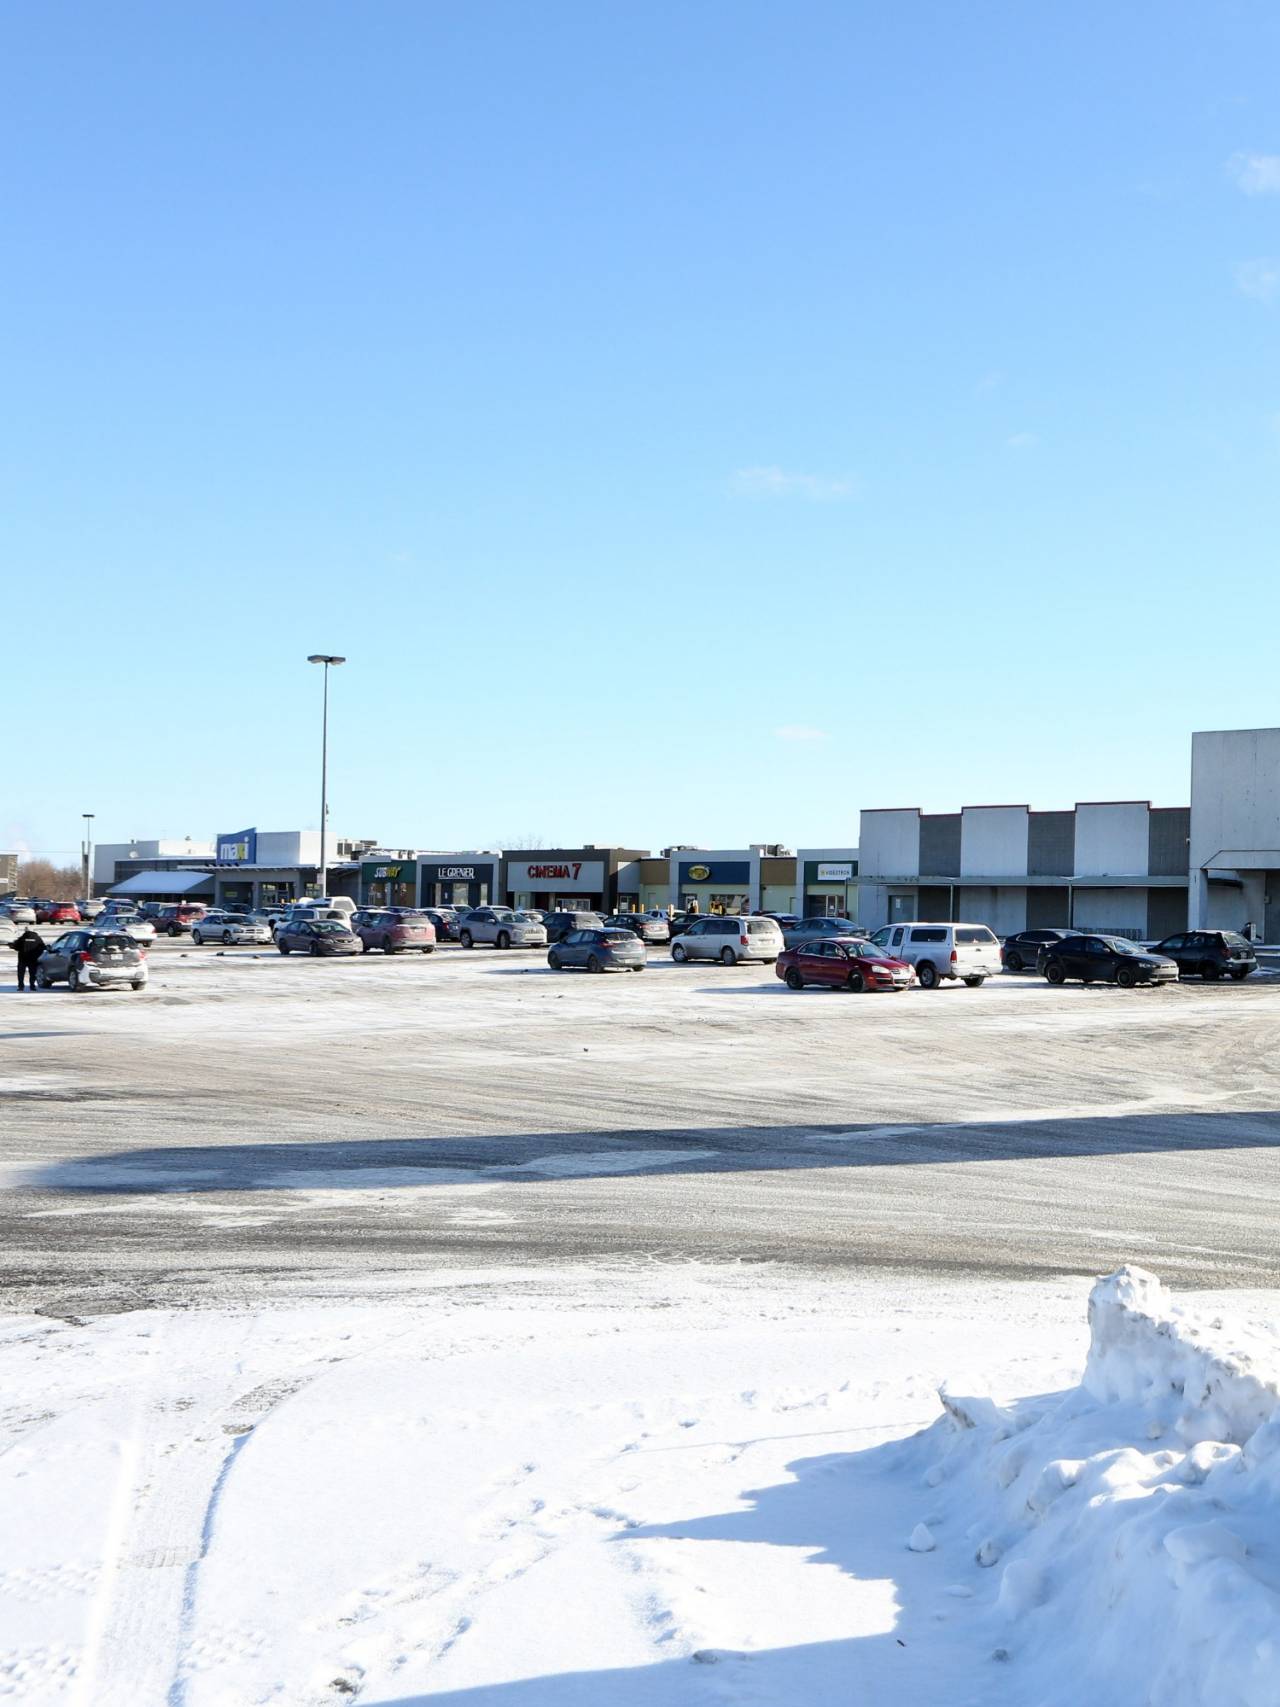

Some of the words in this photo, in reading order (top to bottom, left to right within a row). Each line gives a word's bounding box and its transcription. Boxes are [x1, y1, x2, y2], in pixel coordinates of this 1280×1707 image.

[220, 836, 249, 860] maxi
[374, 866, 402, 878] SUBWAY
[438, 867, 447, 879] LE
[572, 863, 582, 880] 7
